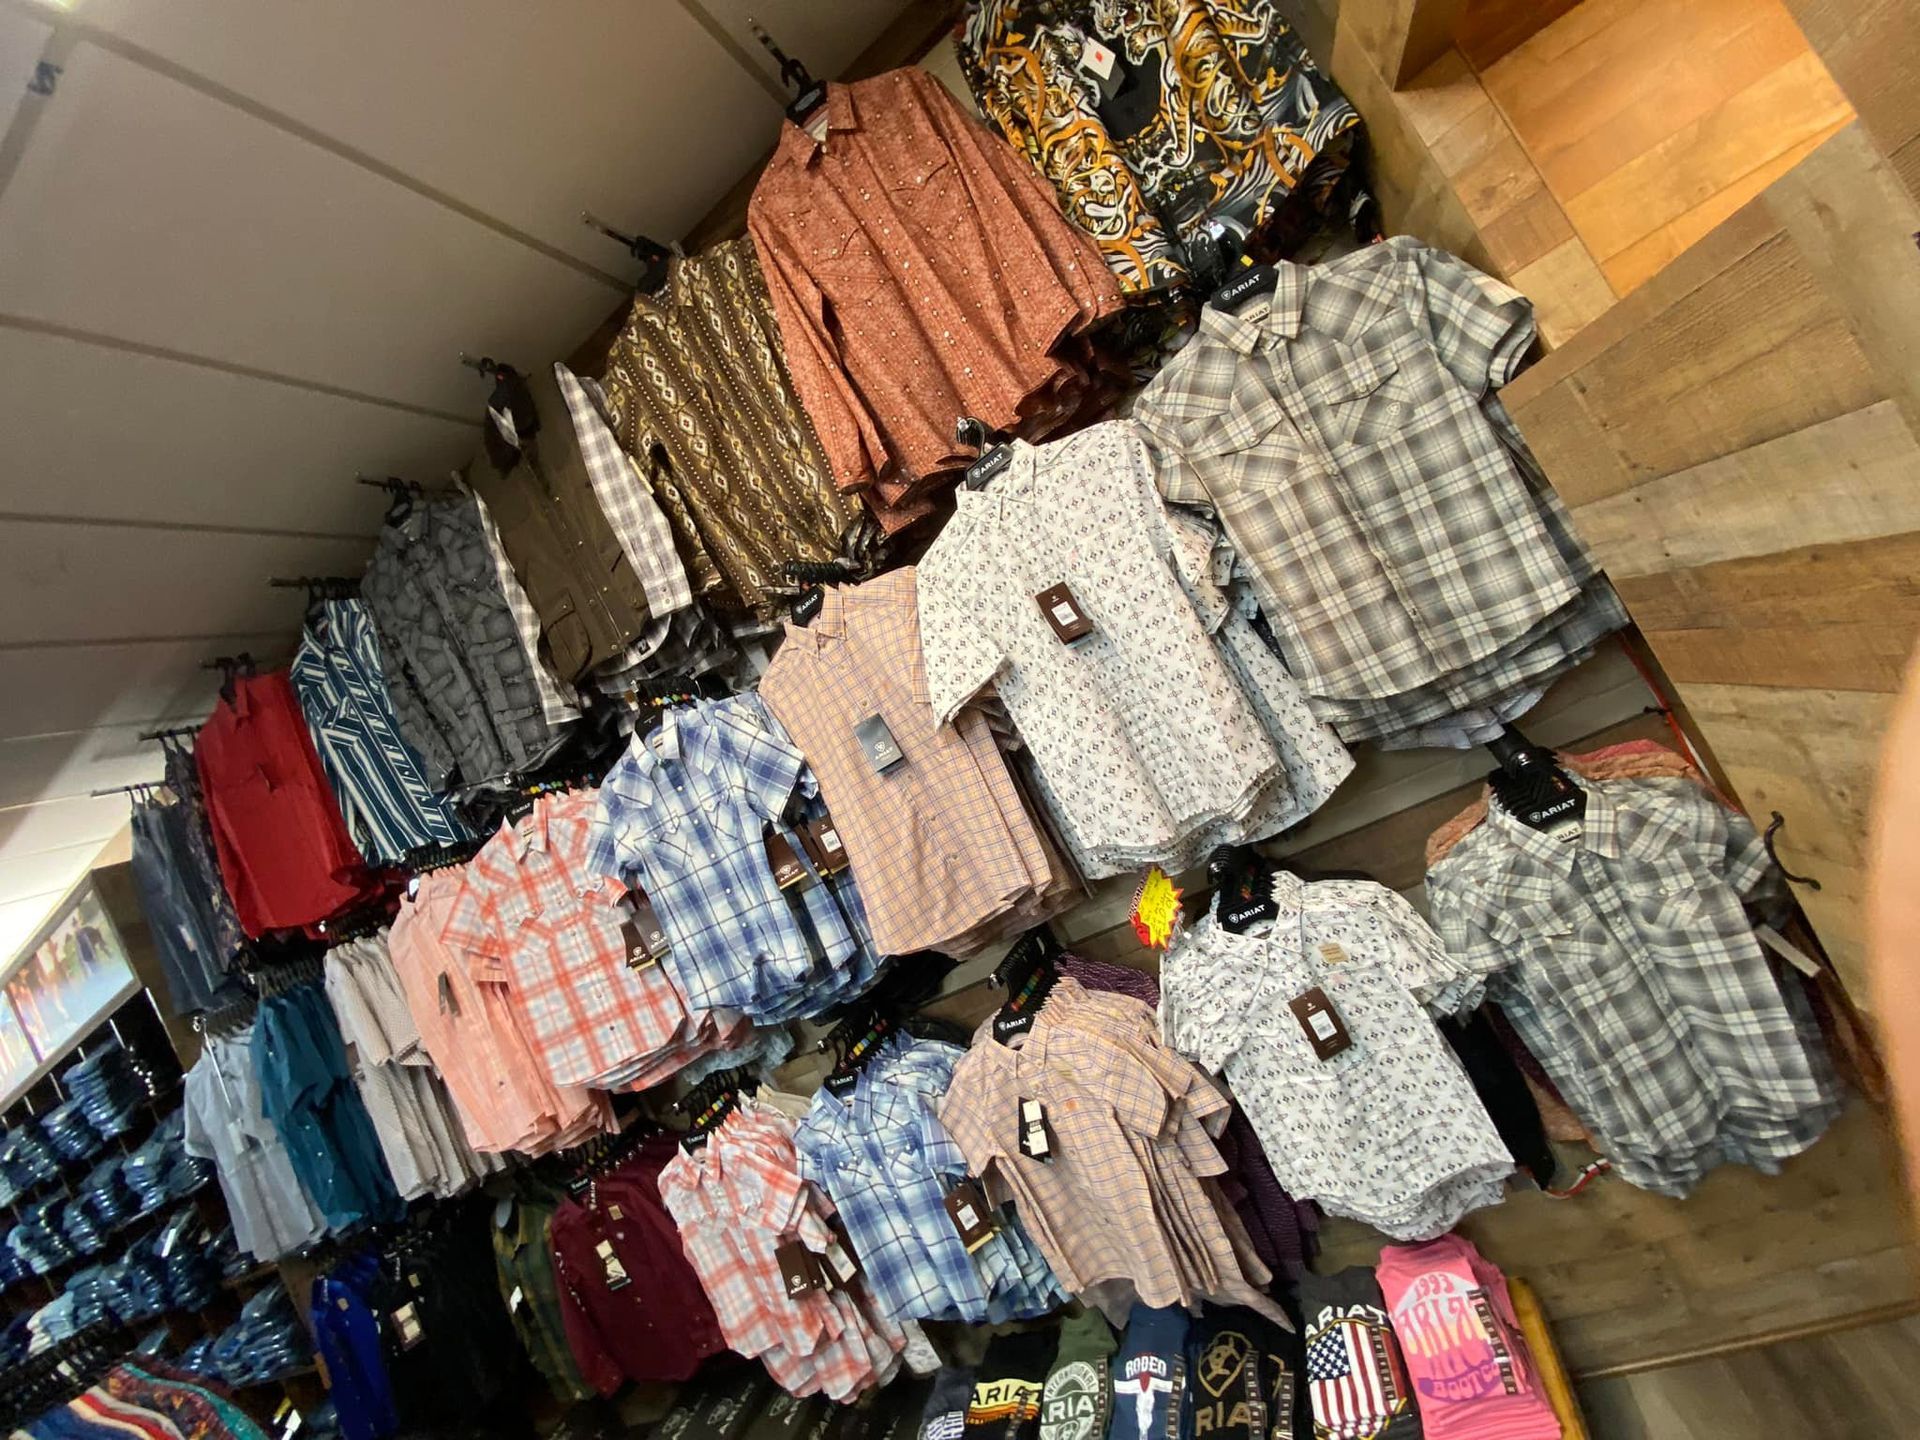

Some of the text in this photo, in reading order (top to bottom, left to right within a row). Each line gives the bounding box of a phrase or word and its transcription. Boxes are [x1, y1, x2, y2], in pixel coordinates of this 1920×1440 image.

[1231, 273, 1260, 296] ARIAT
[981, 452, 1003, 474] ARIAT
[1541, 798, 1576, 819] ARIAT
[1554, 827, 1578, 841] RIAT
[1239, 904, 1265, 921] ARIAT
[1006, 1017, 1027, 1030] ARIAT
[1414, 1273, 1455, 1302] 1993
[1304, 1303, 1387, 1341] ARIAT
[1125, 1355, 1167, 1379] RODEO
[1432, 1371, 1481, 1400] BOOT
[1041, 1394, 1106, 1423] RIA
